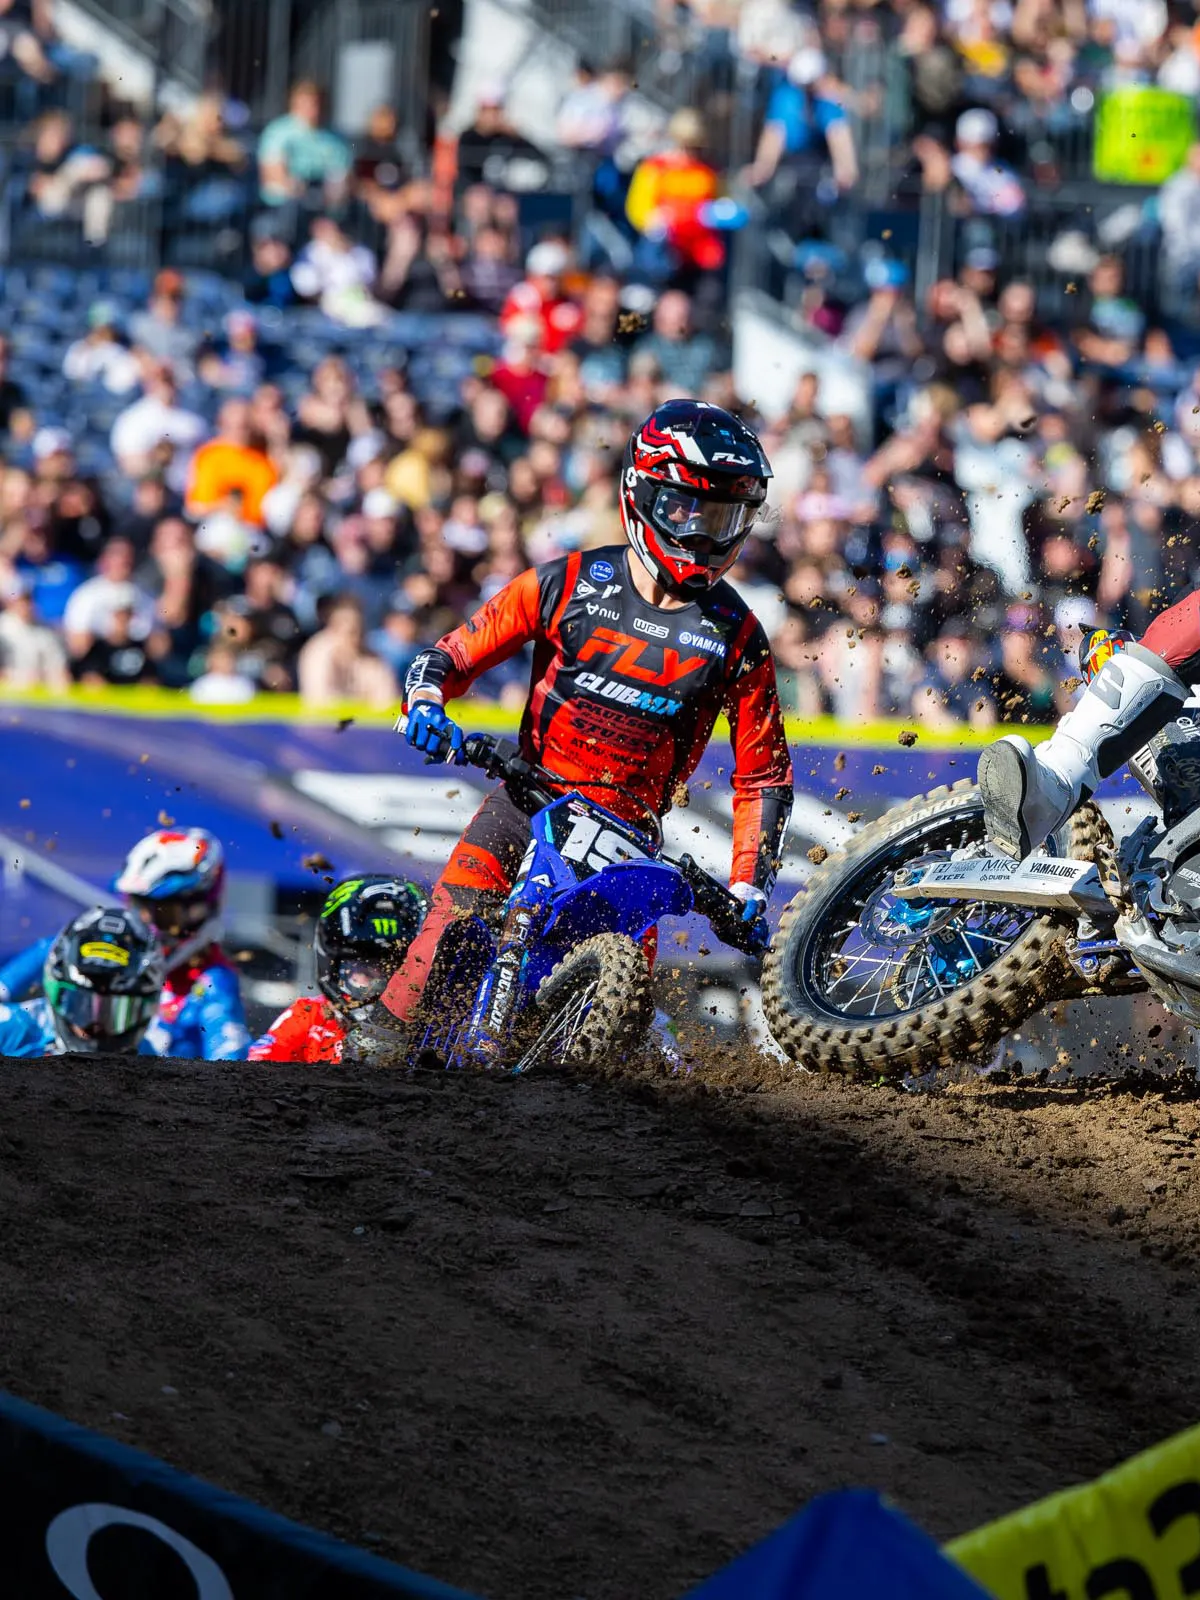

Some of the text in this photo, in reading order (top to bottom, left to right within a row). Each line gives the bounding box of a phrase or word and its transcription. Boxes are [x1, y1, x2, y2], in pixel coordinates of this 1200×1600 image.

[712, 452, 755, 466] FLY
[692, 634, 726, 657] YAMAH
[577, 626, 708, 687] FLY
[574, 672, 684, 717] CLUBMX
[935, 873, 966, 881] EXCEL
[1029, 861, 1080, 879] YAMALUBE
